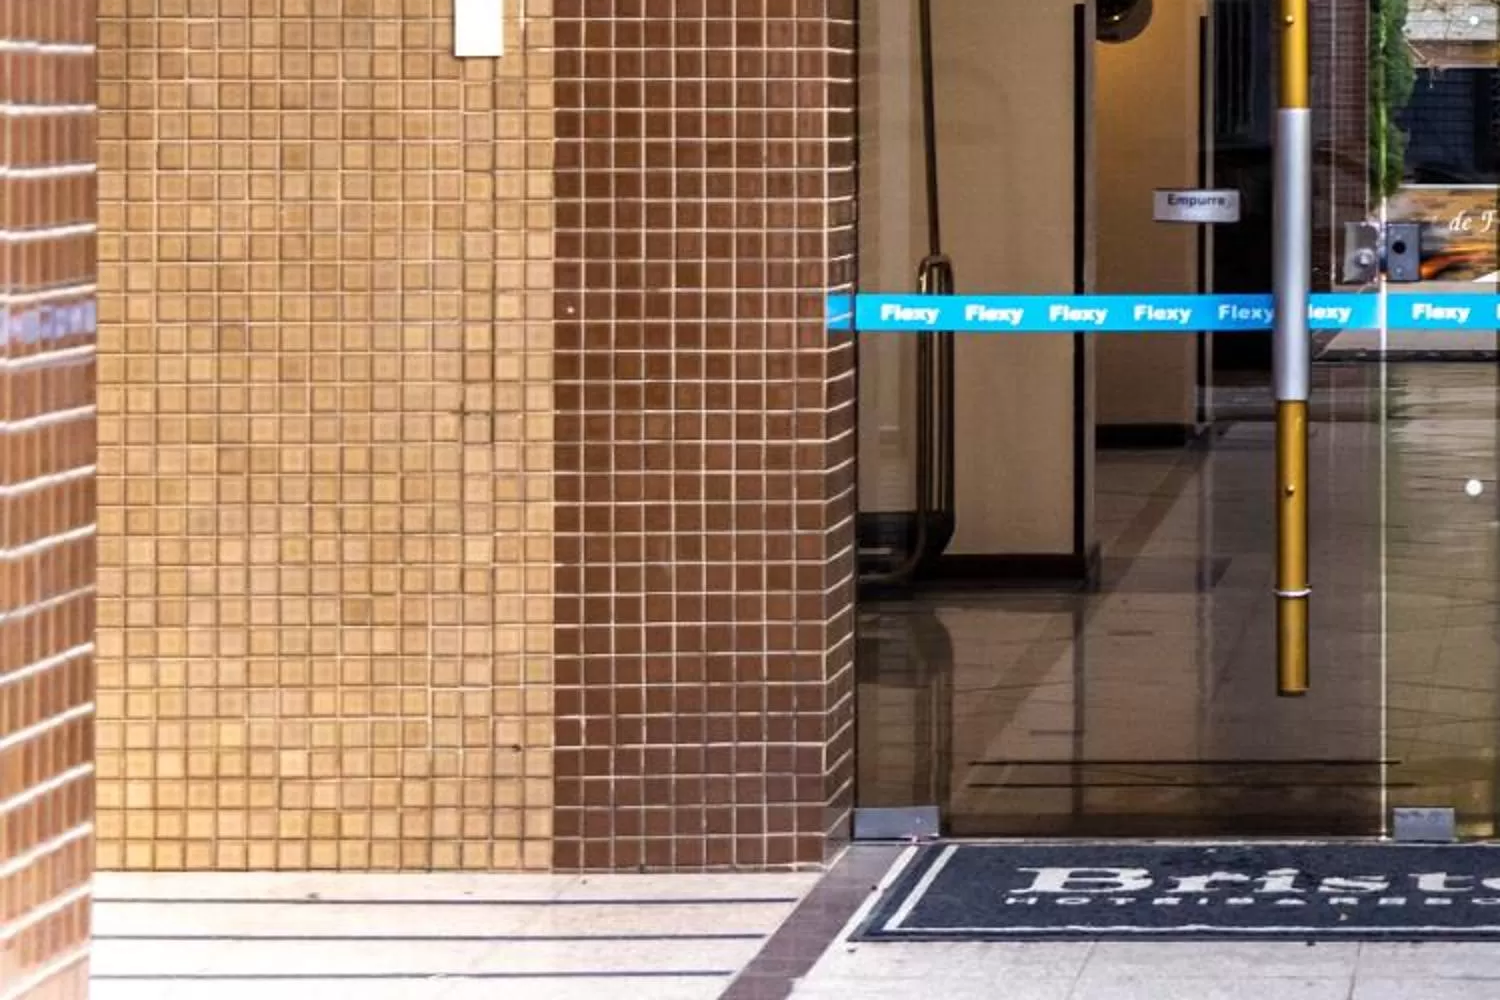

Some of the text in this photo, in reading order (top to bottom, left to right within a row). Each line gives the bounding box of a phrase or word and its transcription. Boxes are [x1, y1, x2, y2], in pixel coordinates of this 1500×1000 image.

[881, 304, 941, 324] Flexy
[966, 304, 1024, 325] Flexy
[1050, 304, 1108, 325] Flexy
[1134, 304, 1192, 324] Flexy
[1308, 304, 1352, 324] lexy
[1412, 304, 1471, 324] Flexy
